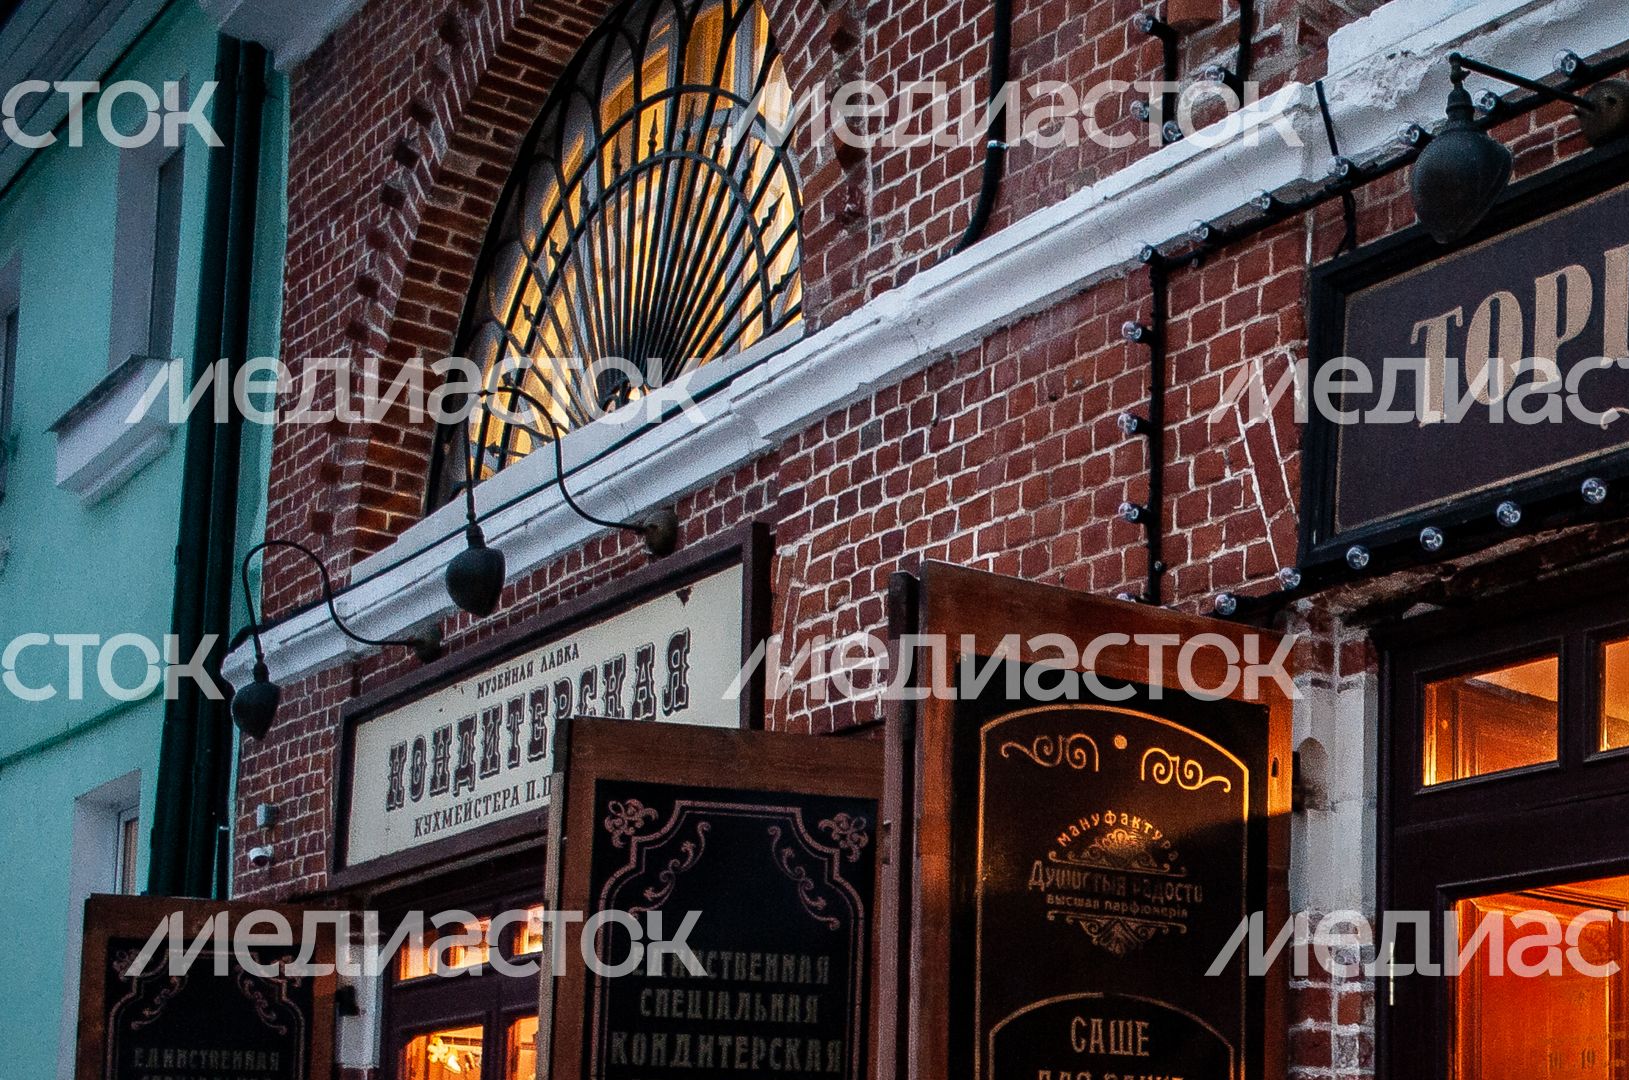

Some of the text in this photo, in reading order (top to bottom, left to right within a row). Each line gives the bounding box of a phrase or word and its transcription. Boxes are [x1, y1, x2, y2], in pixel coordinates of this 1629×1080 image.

[477, 643, 579, 699] МУЗЕЙНАЯ ЛАВКА
[414, 782, 520, 838] КУХМЕЙСТЕРА
[1057, 810, 1179, 862] мануфактура
[133, 1048, 280, 1071] ЕДИНСТВЕННАЯ
[610, 1031, 842, 1074] КОНДИТЕРСКАЯ
[1070, 1015, 1150, 1057] САШЕ
